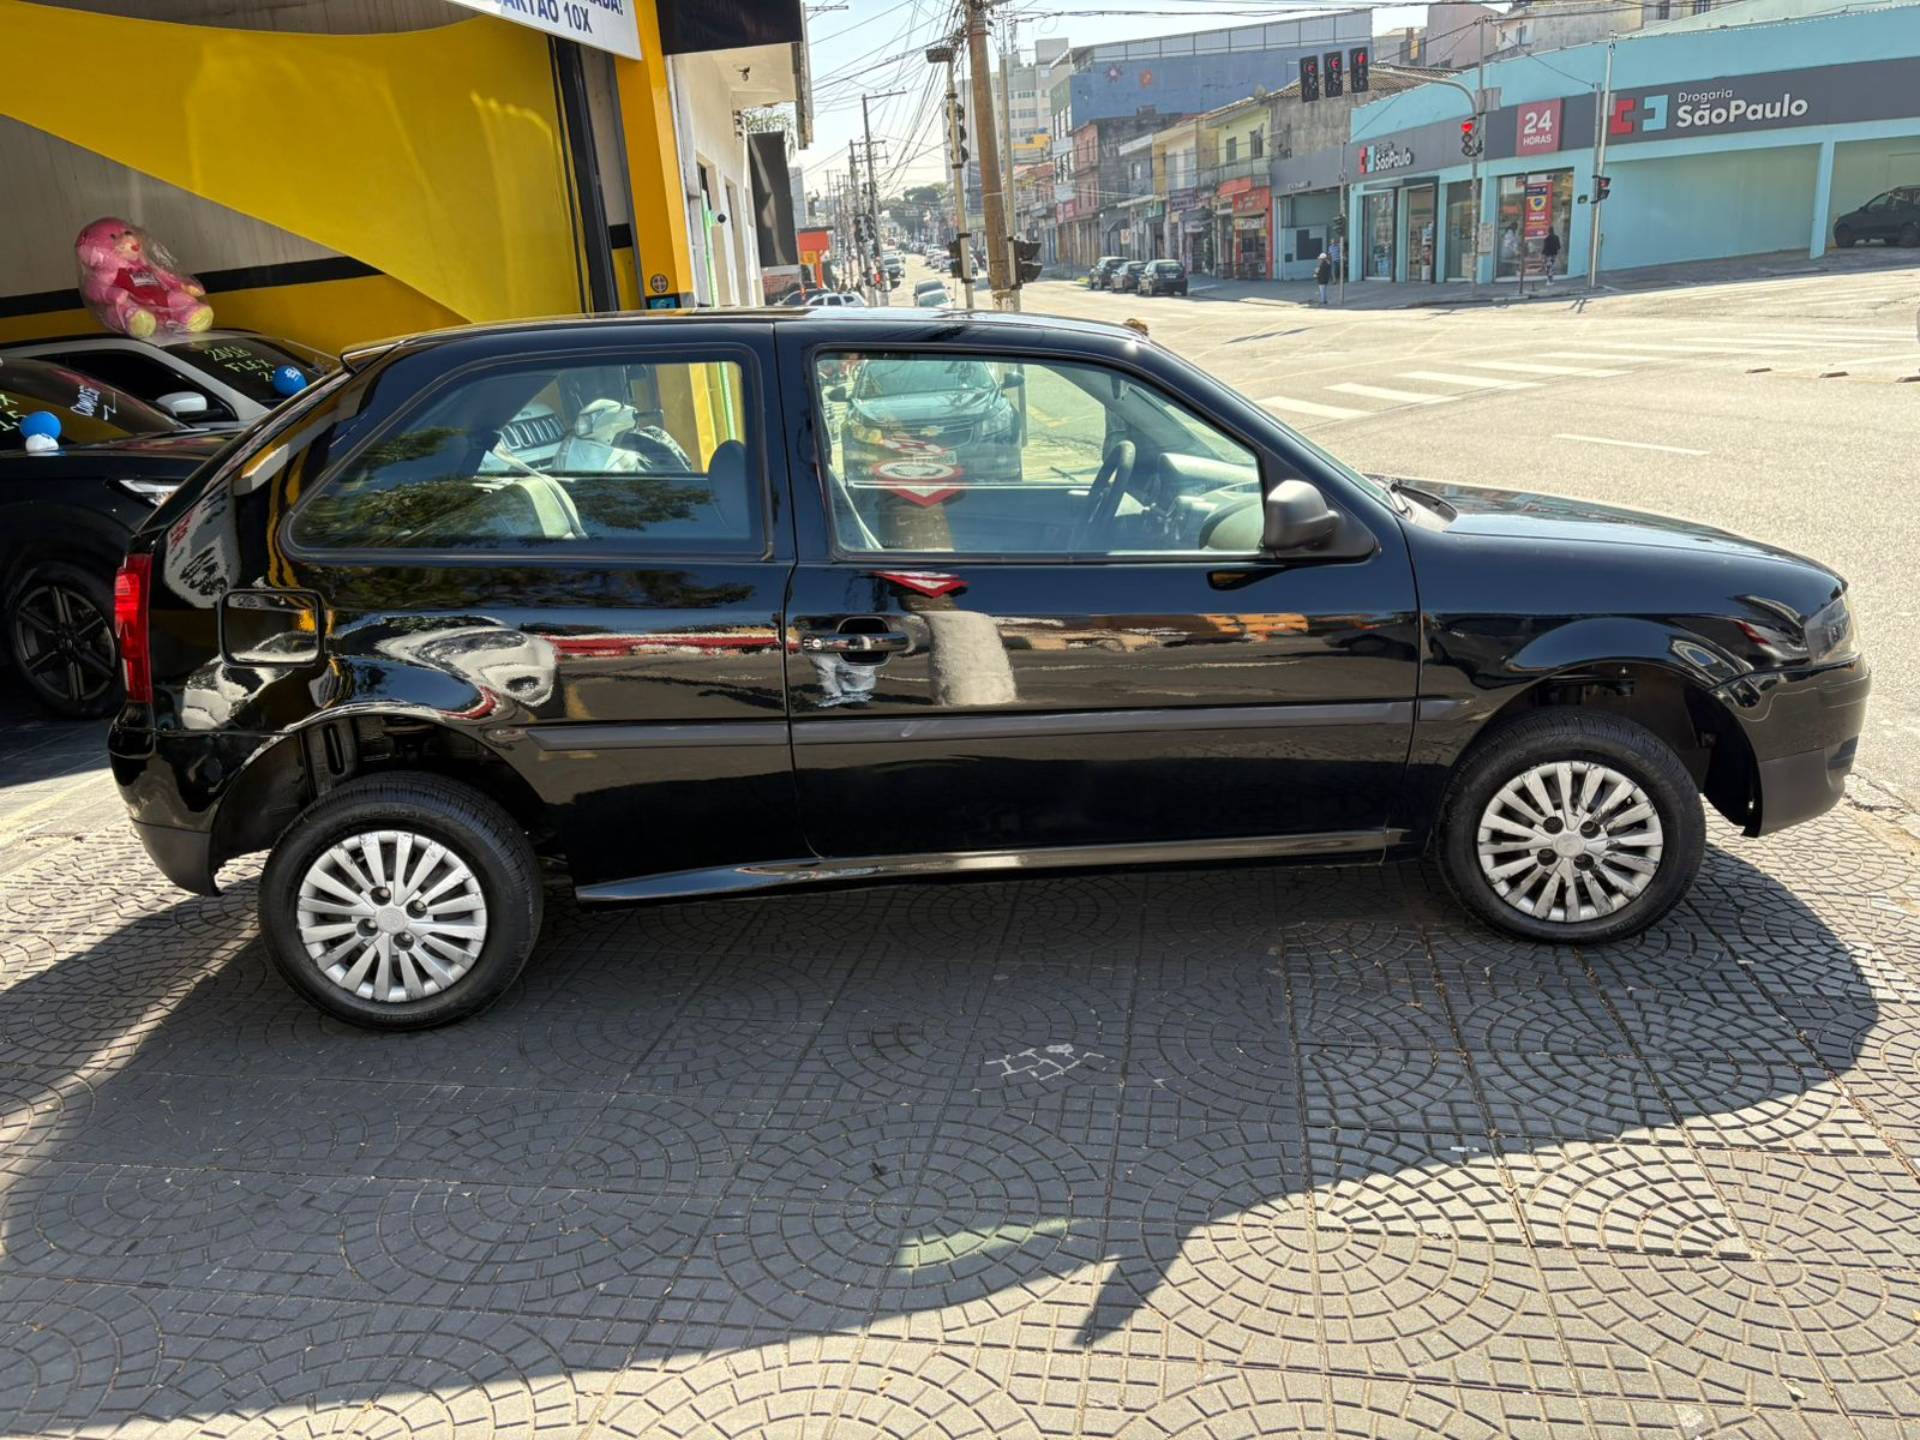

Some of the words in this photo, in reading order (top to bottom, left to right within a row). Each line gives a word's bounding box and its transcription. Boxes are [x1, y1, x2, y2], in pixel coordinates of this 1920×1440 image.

[564, 3, 593, 34] 10X
[1678, 88, 1733, 104] Drogaria
[1523, 109, 1553, 135] 24
[1523, 134, 1553, 146] HORAS
